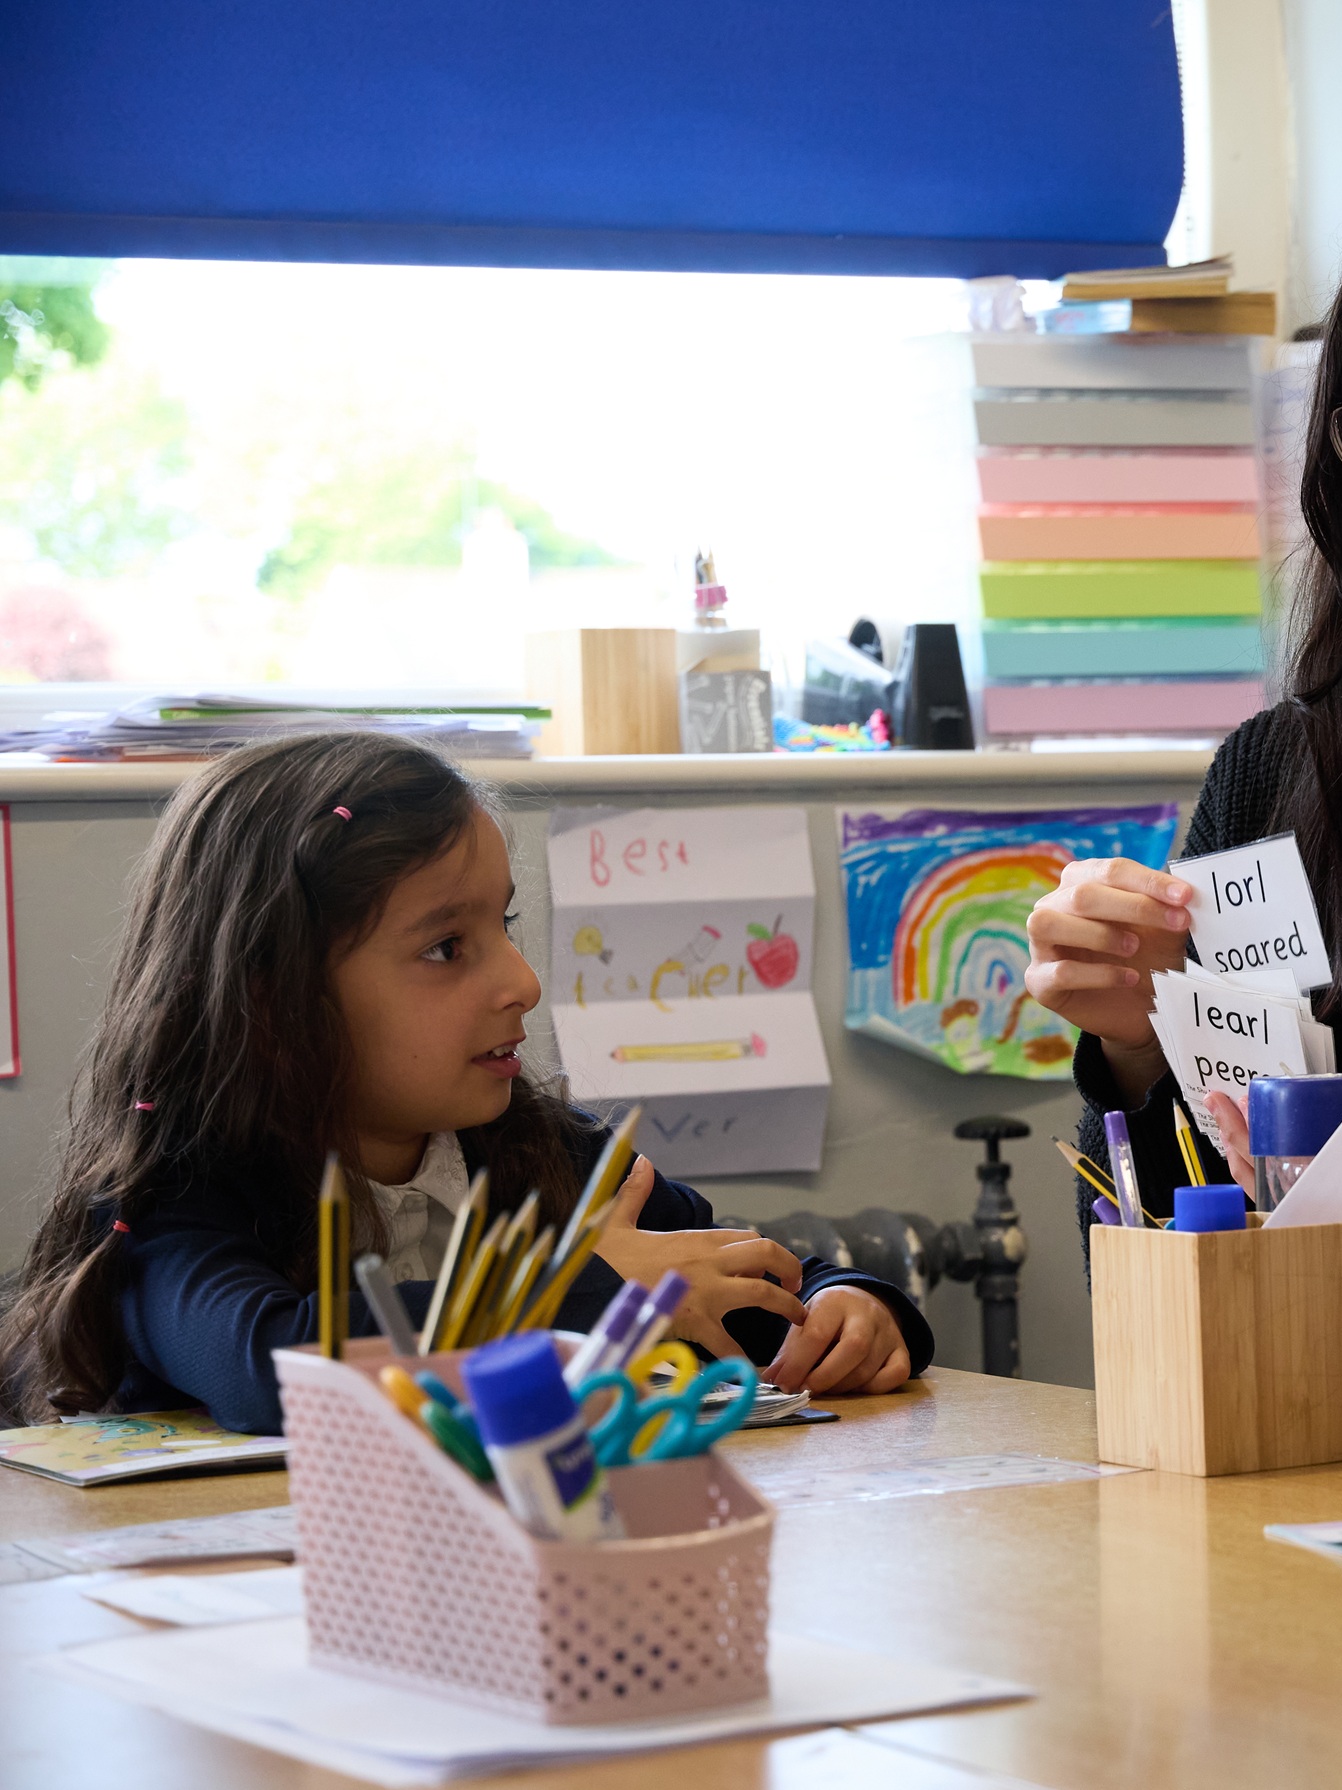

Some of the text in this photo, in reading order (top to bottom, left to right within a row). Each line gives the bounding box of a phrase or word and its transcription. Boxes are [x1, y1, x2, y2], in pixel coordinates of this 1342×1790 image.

[588, 828, 690, 888] Best
[1215, 921, 1307, 973] soared
[1194, 1055, 1270, 1087] peer
